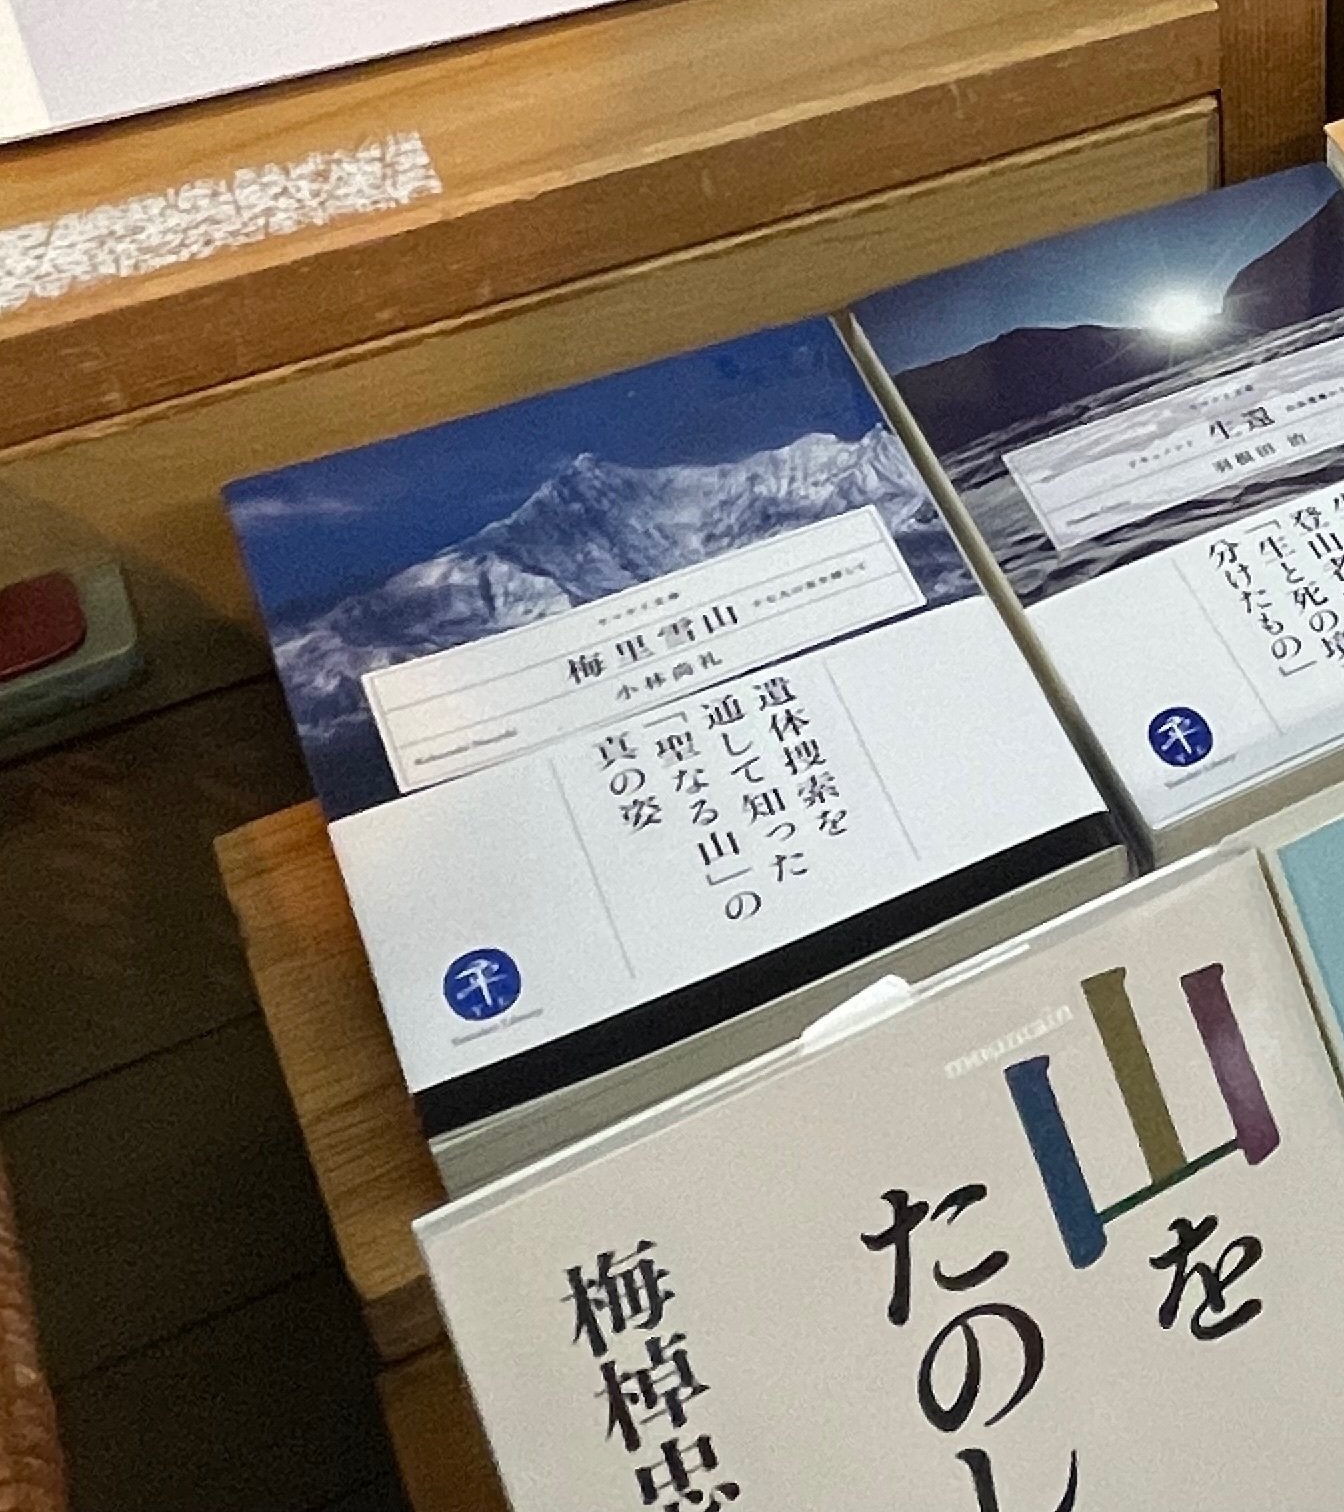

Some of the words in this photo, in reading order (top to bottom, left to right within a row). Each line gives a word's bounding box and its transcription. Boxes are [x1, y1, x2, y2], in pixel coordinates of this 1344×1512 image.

[1208, 405, 1275, 440] 生還
[567, 605, 738, 685] 梅里雪山
[1208, 538, 1317, 677] 分けたもの」
[598, 731, 662, 831] 真の姿
[644, 711, 762, 920] 「聖なる山」の
[700, 693, 808, 882] 通して知った
[752, 676, 847, 836] 遺体捜索を
[1003, 962, 1282, 1341] 山を
[558, 1238, 742, 1512] 梅棹忠
